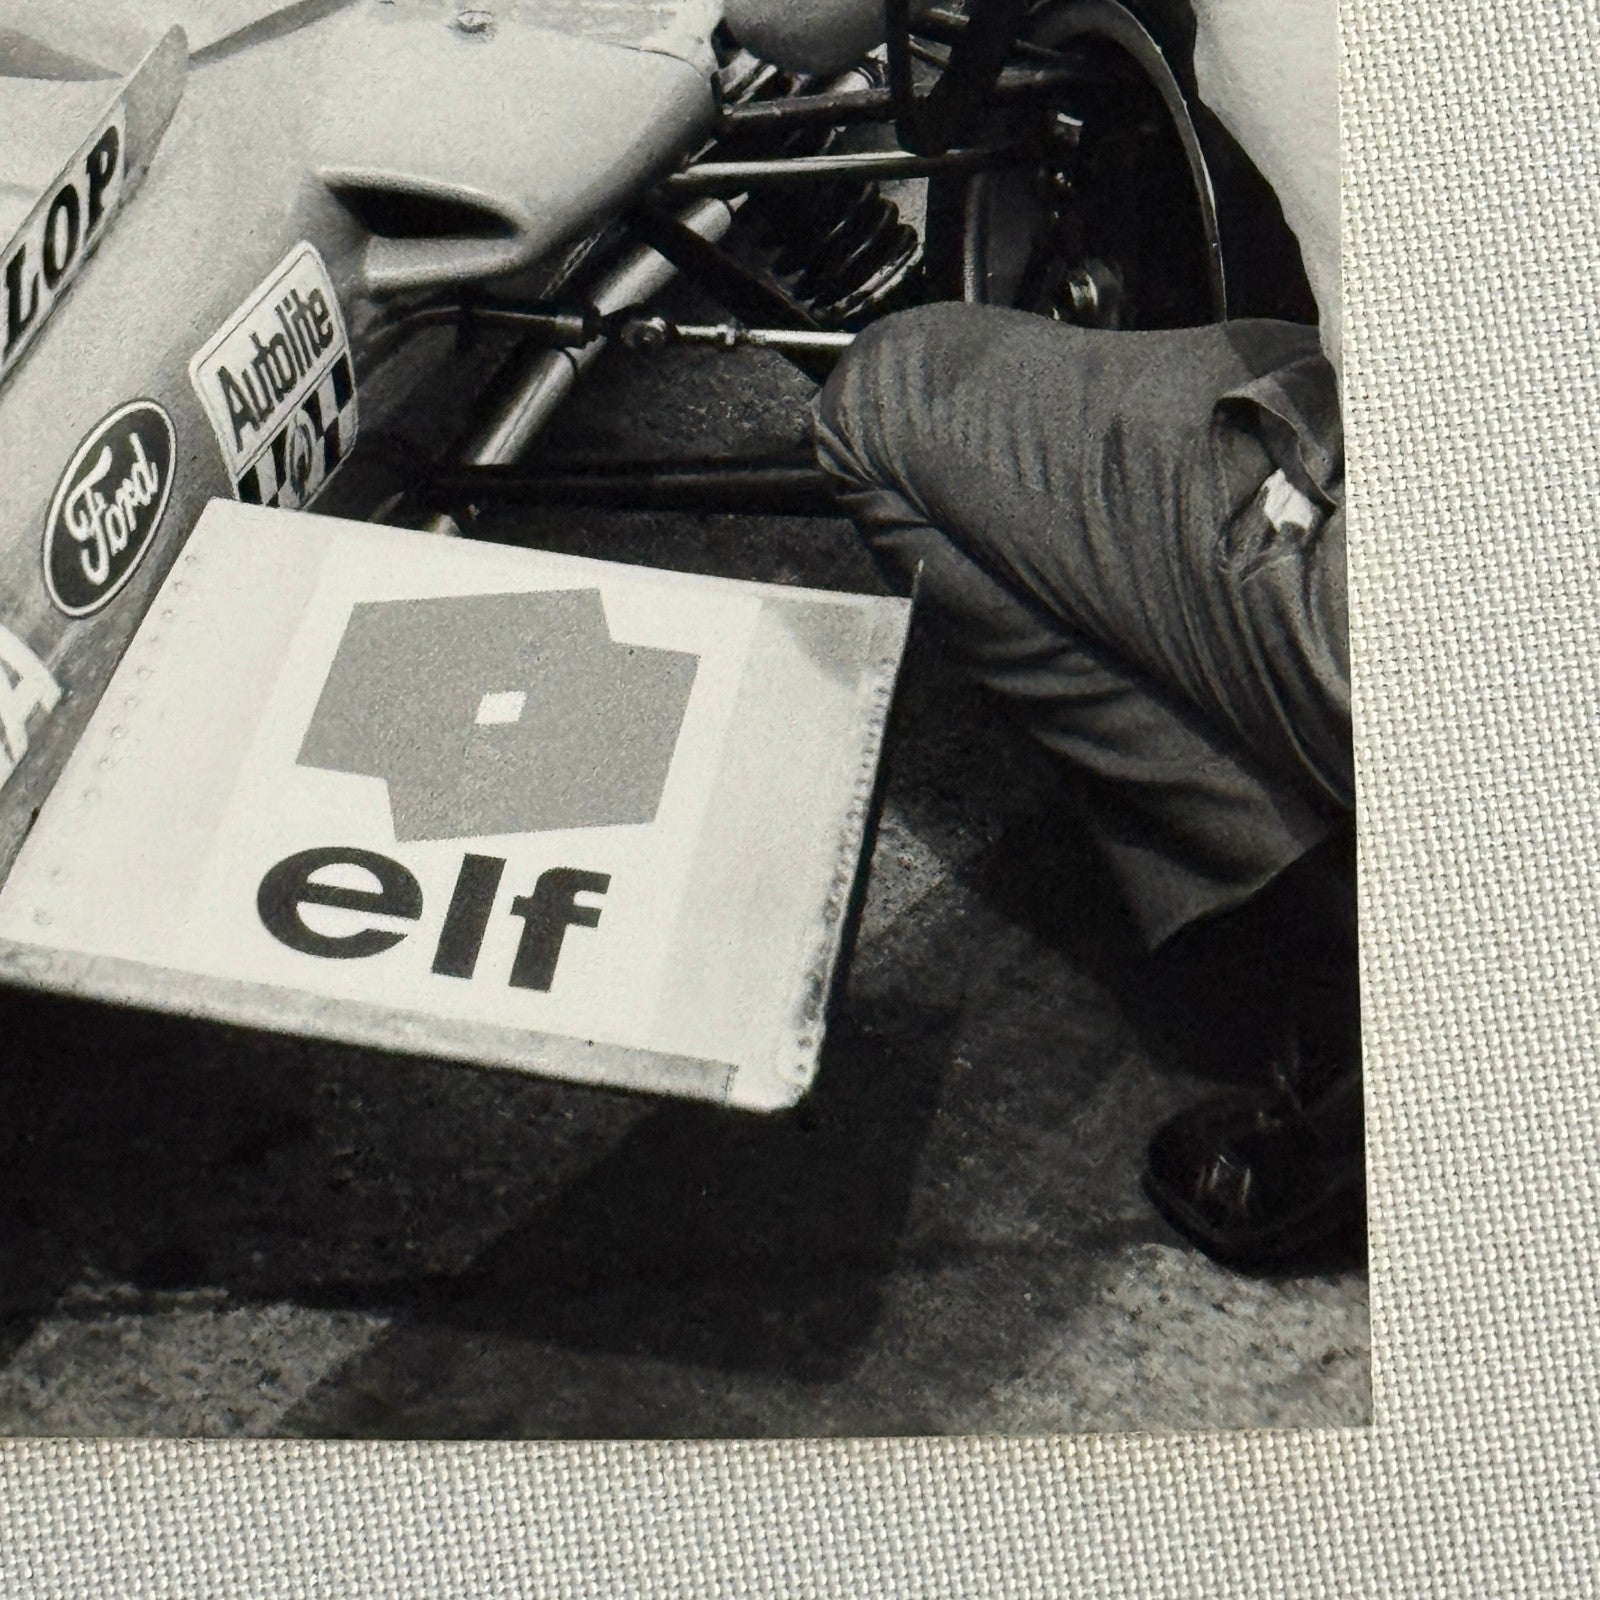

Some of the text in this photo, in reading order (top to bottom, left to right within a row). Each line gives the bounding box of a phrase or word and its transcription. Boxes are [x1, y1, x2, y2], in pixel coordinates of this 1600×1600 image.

[216, 288, 334, 452] Autolite
[64, 432, 158, 585] Ford
[257, 846, 612, 993] elf
